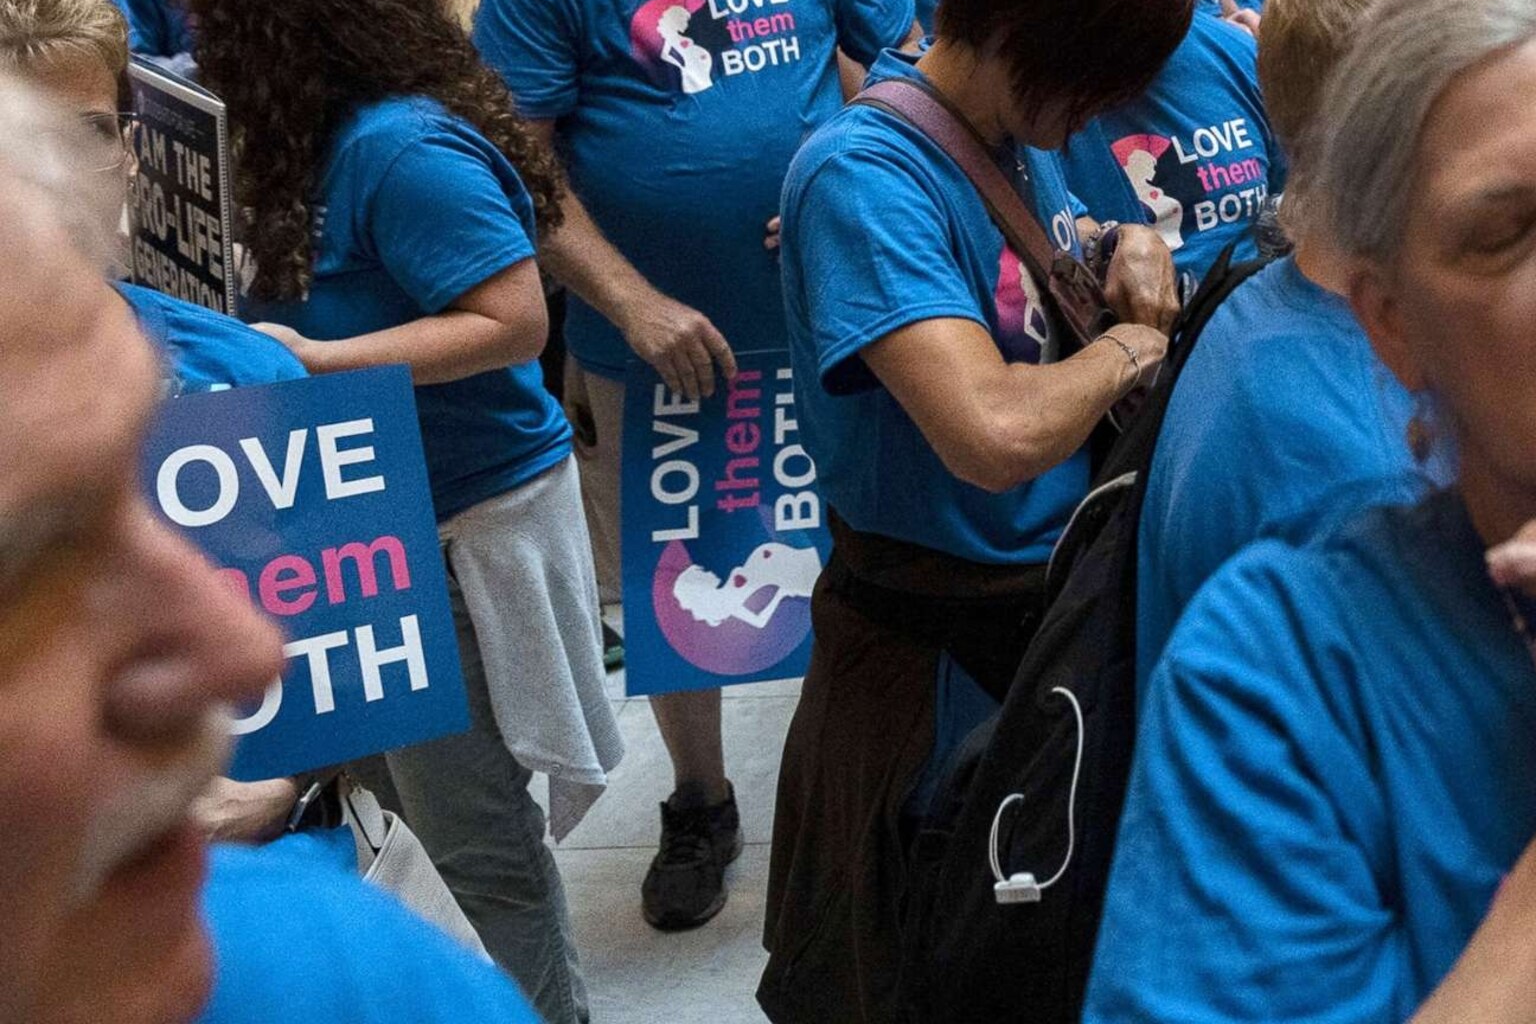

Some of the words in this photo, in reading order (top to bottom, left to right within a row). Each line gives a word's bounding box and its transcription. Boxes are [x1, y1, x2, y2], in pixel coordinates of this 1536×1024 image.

[721, 36, 801, 76] BOTH
[726, 11, 796, 43] them
[140, 125, 168, 175] AM
[173, 140, 213, 202] THE
[1171, 118, 1252, 164] LOVE
[1196, 158, 1262, 192] them
[651, 383, 700, 542] LOVE
[715, 370, 762, 513] them
[157, 418, 386, 528] OVE
